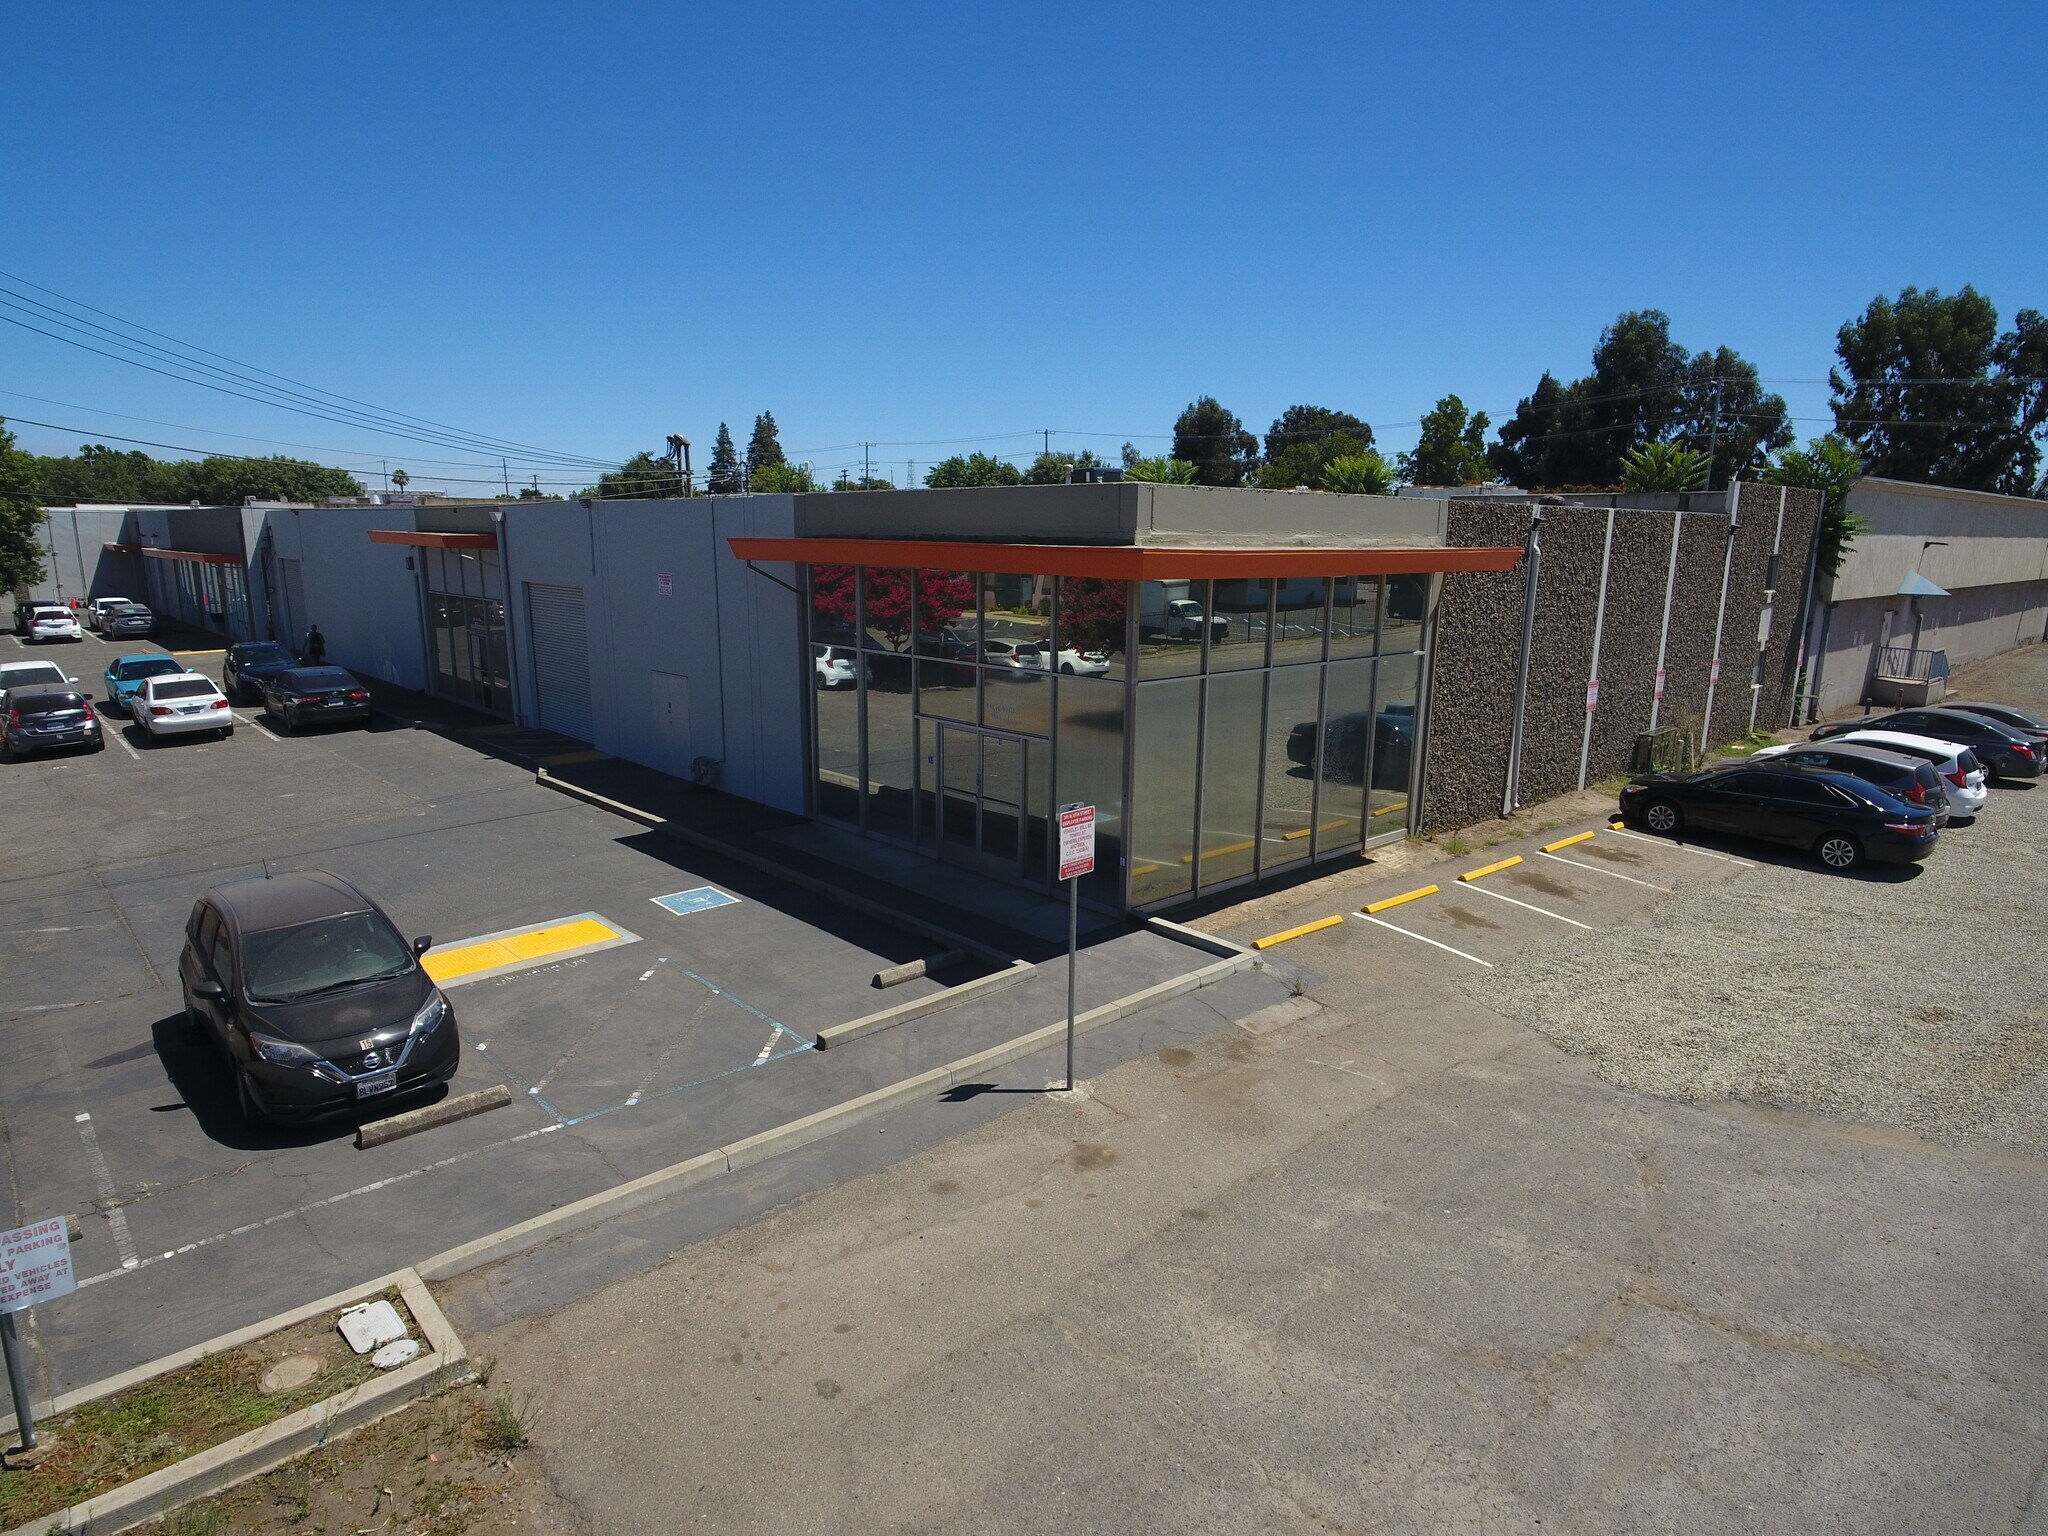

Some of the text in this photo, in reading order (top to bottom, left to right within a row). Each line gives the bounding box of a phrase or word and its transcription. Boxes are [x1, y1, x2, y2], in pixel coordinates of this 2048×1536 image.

[1063, 826, 1079, 835] VEHICLES
[362, 1040, 373, 1049] 15
[7, 1234, 63, 1257] PARKING
[14, 1258, 68, 1280] VEHICLES
[21, 1273, 50, 1288] AWAY
[55, 1267, 68, 1278] AT
[0, 1282, 51, 1304] EXPENSE
